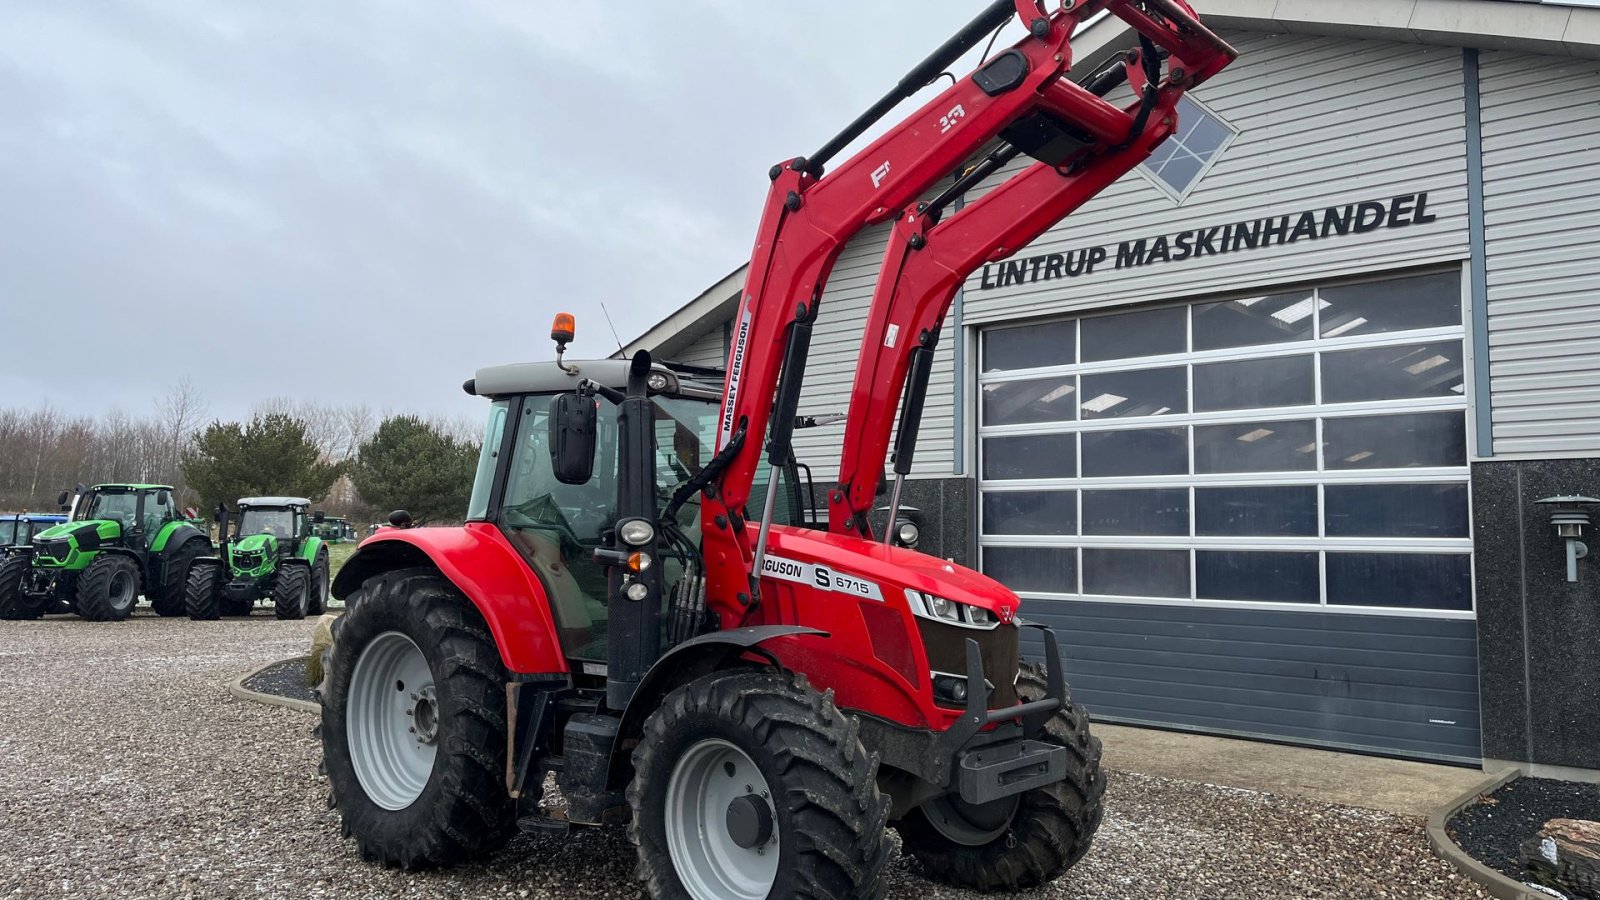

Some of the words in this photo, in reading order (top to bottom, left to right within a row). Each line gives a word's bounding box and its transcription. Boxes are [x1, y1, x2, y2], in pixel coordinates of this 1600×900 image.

[980, 246, 1106, 290] LINTRUP
[1115, 192, 1437, 270] MASKINHANDEL
[724, 385, 736, 431] MASSEY
[733, 322, 748, 382] FERGUSON
[815, 567, 831, 587] S
[835, 577, 869, 594] 6715
